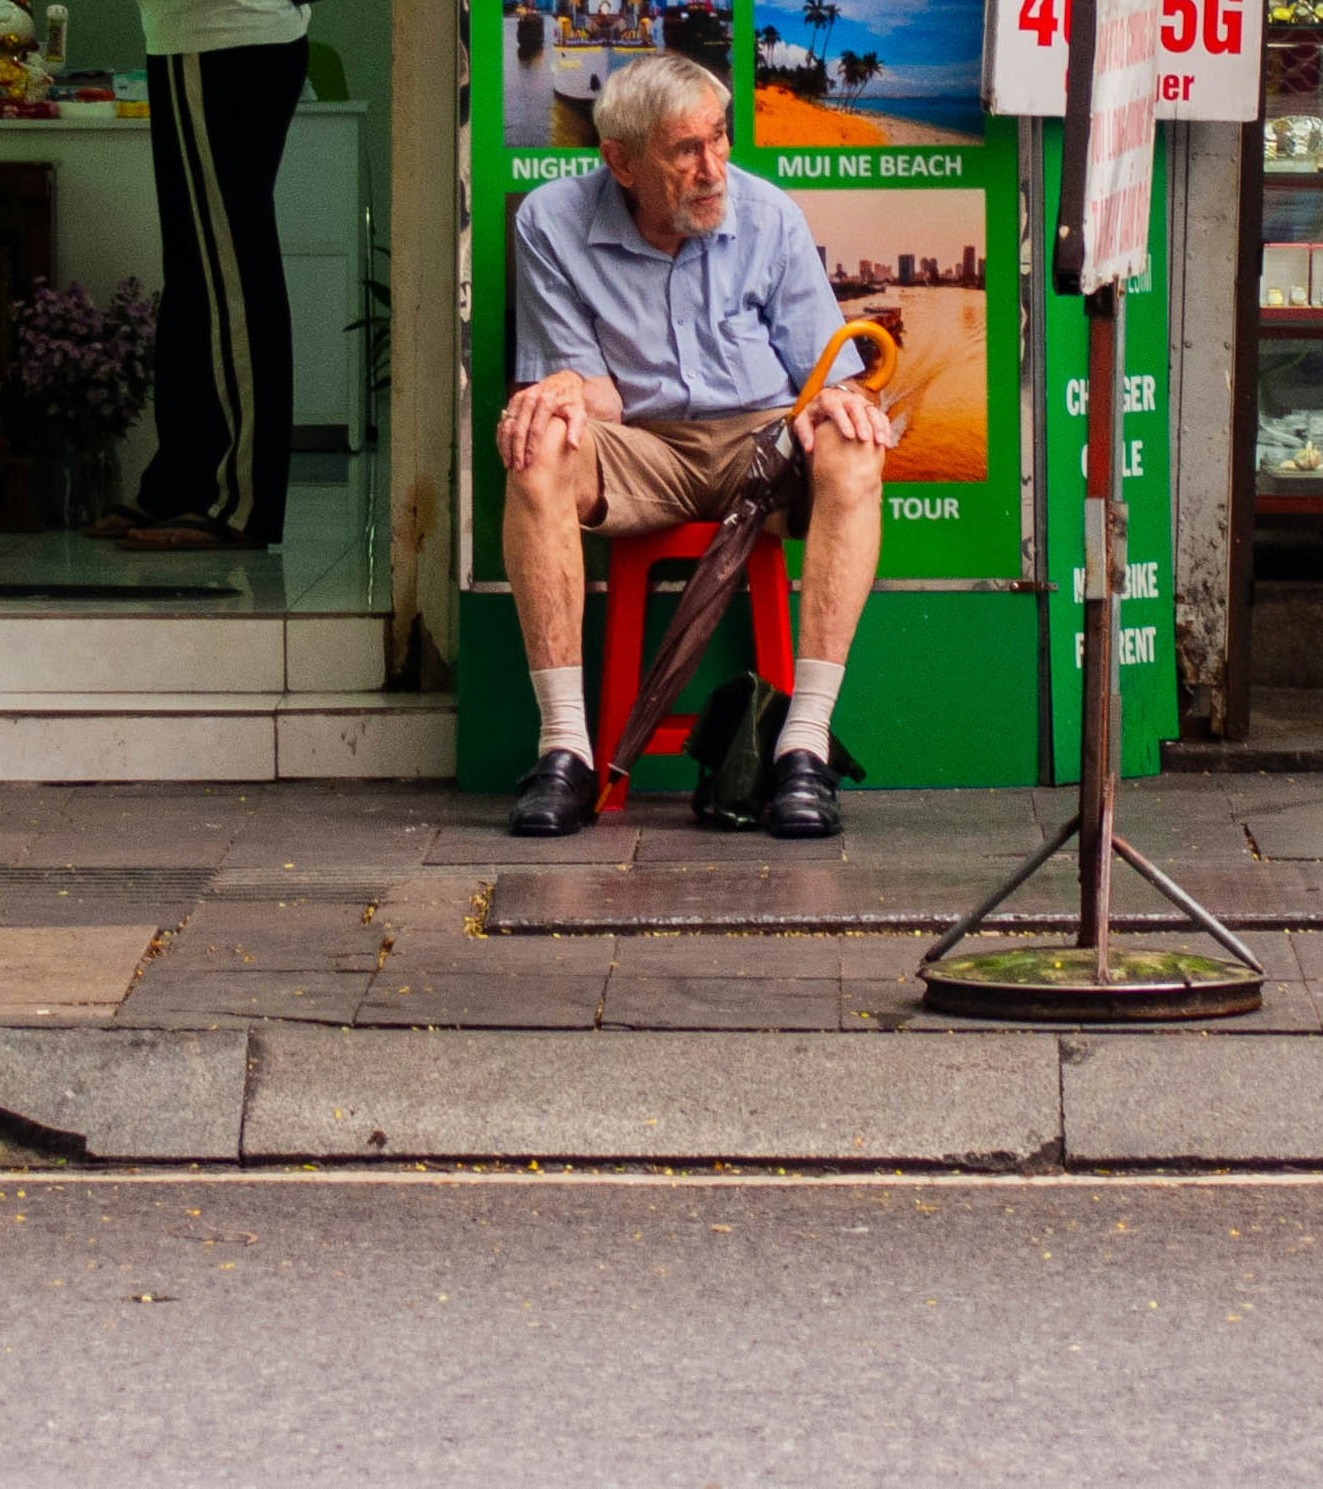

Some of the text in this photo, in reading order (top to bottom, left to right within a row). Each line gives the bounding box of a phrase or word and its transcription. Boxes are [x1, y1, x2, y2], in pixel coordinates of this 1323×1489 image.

[779, 156, 961, 178] MUI NE BEACH
[889, 498, 958, 519] TOUR
